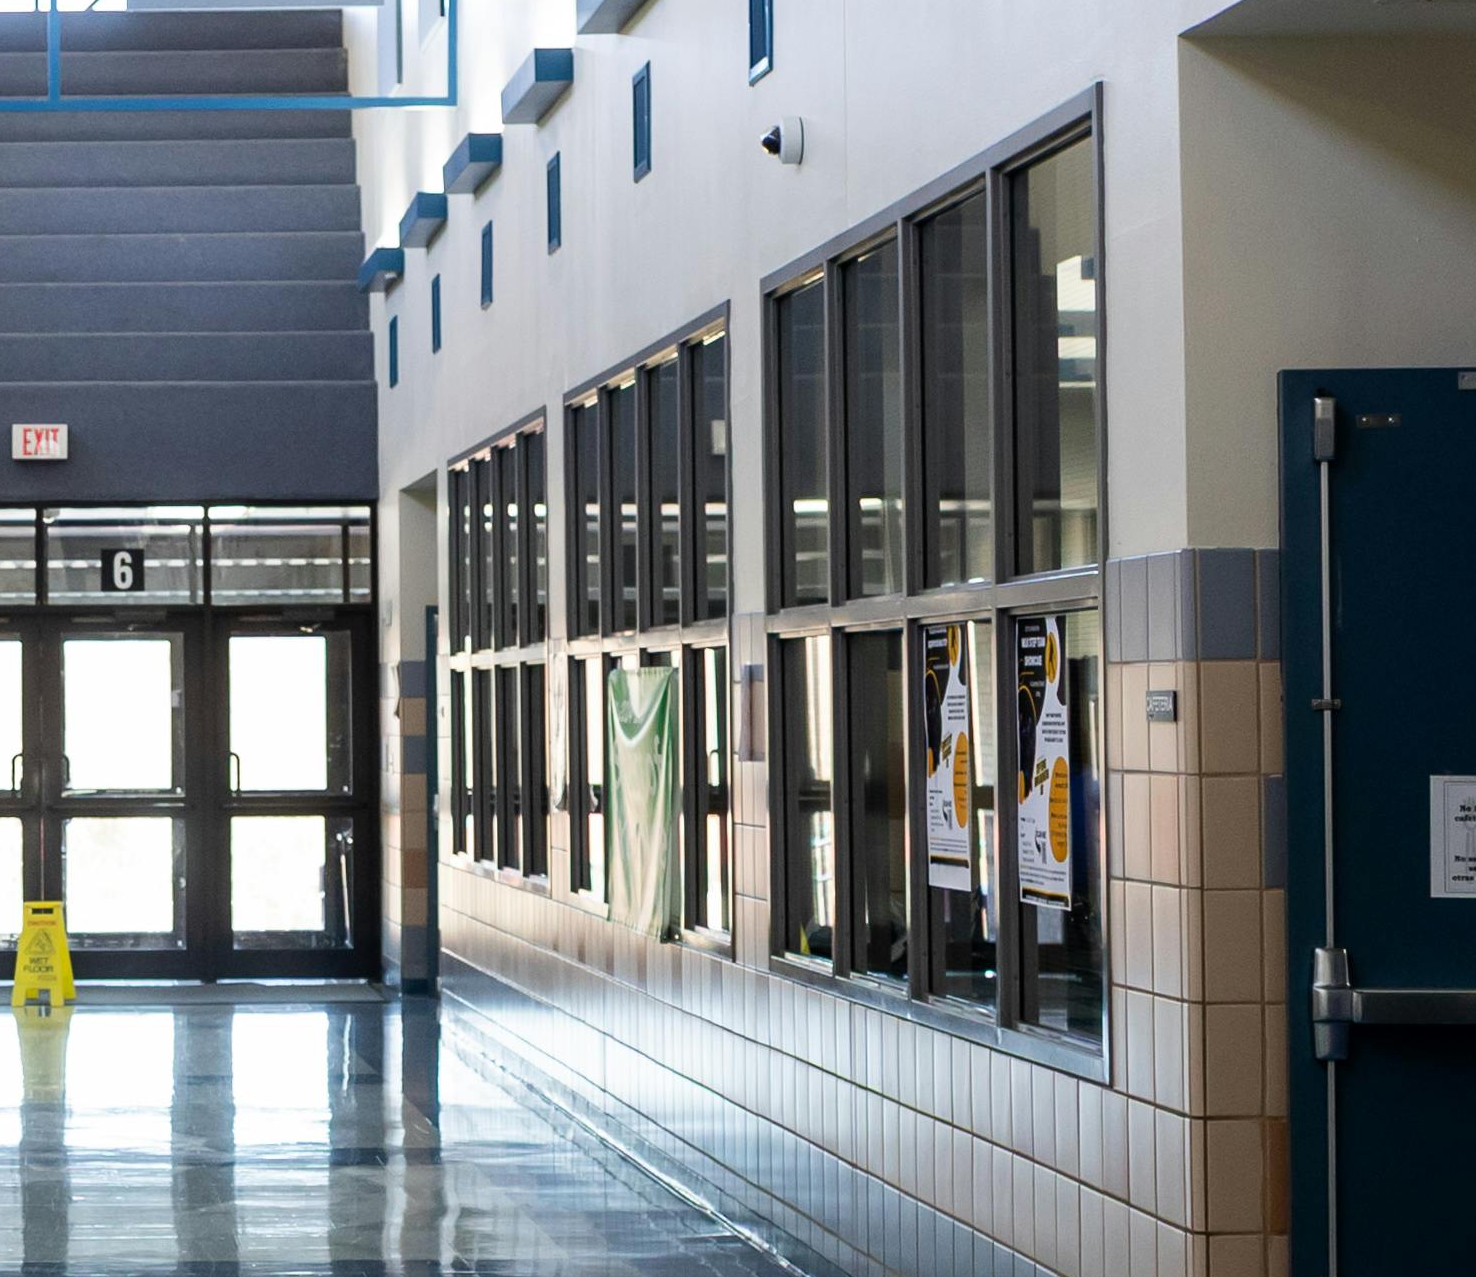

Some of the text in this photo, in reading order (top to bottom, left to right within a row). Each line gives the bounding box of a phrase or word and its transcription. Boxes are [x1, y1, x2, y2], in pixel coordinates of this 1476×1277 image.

[22, 428, 59, 456] EXIT
[113, 551, 134, 590] 6
[1460, 805, 1471, 813] No
[1454, 855, 1467, 863] No
